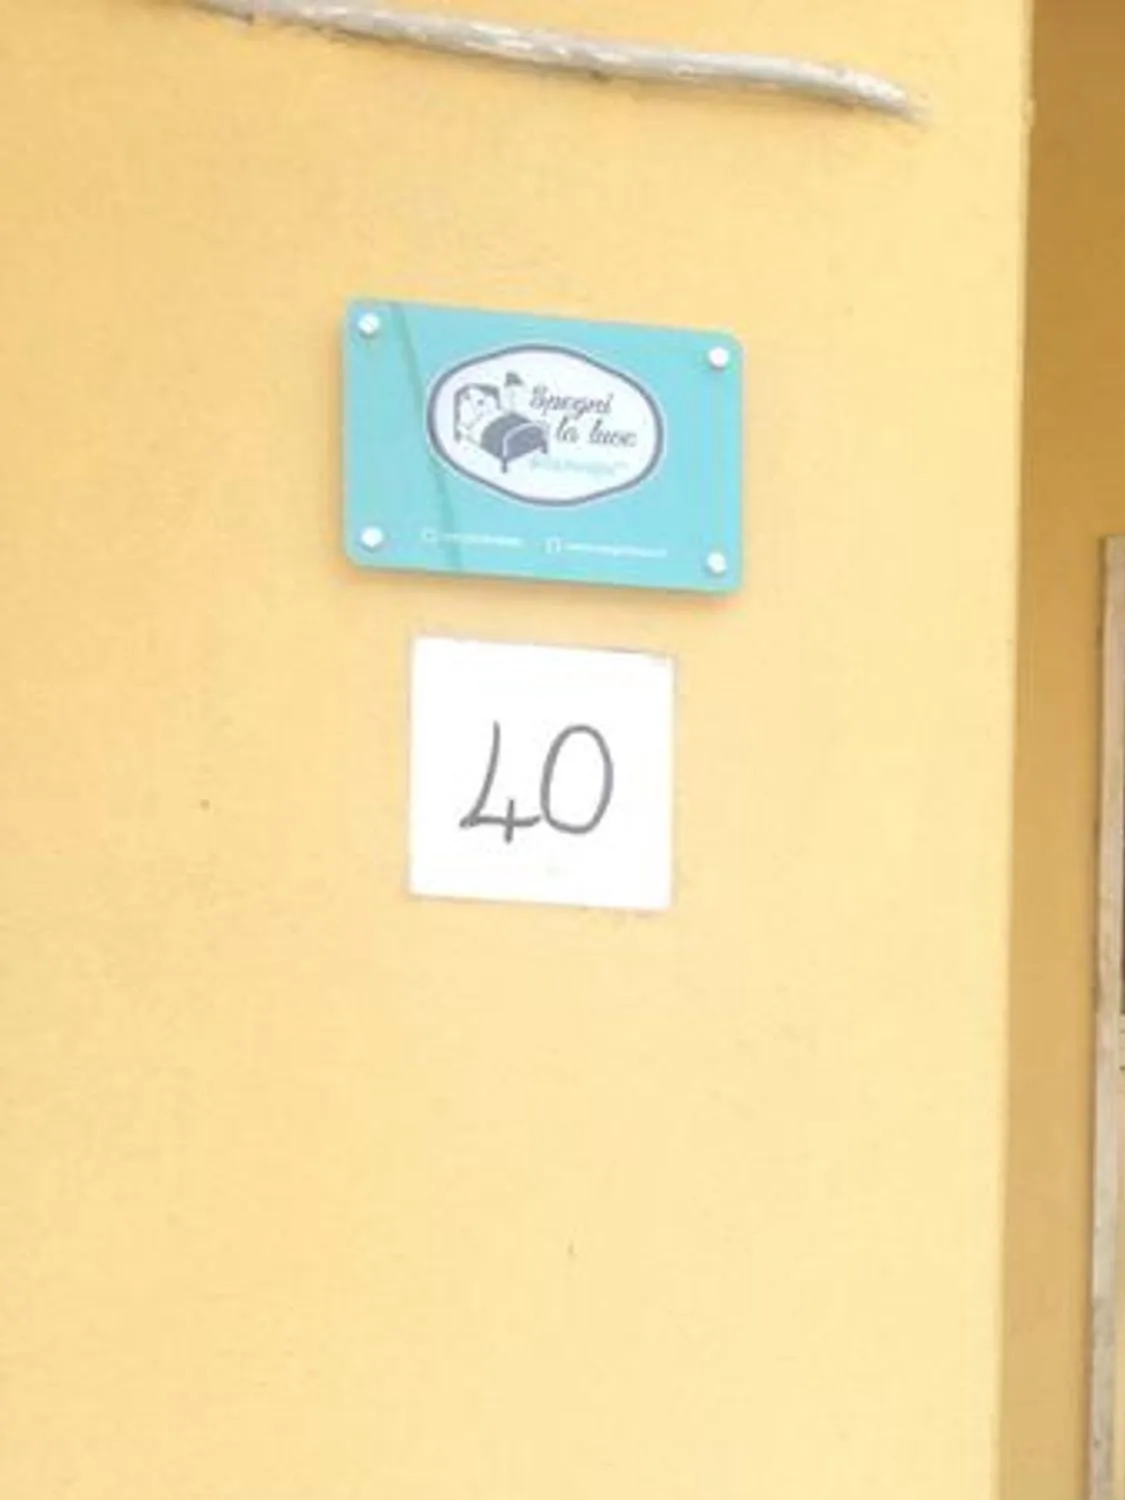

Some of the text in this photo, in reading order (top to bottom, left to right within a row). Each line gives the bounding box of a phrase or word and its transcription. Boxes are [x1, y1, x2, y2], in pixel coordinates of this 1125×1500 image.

[529, 384, 614, 421] Spegni
[556, 416, 579, 444] la
[458, 719, 614, 844] 40
